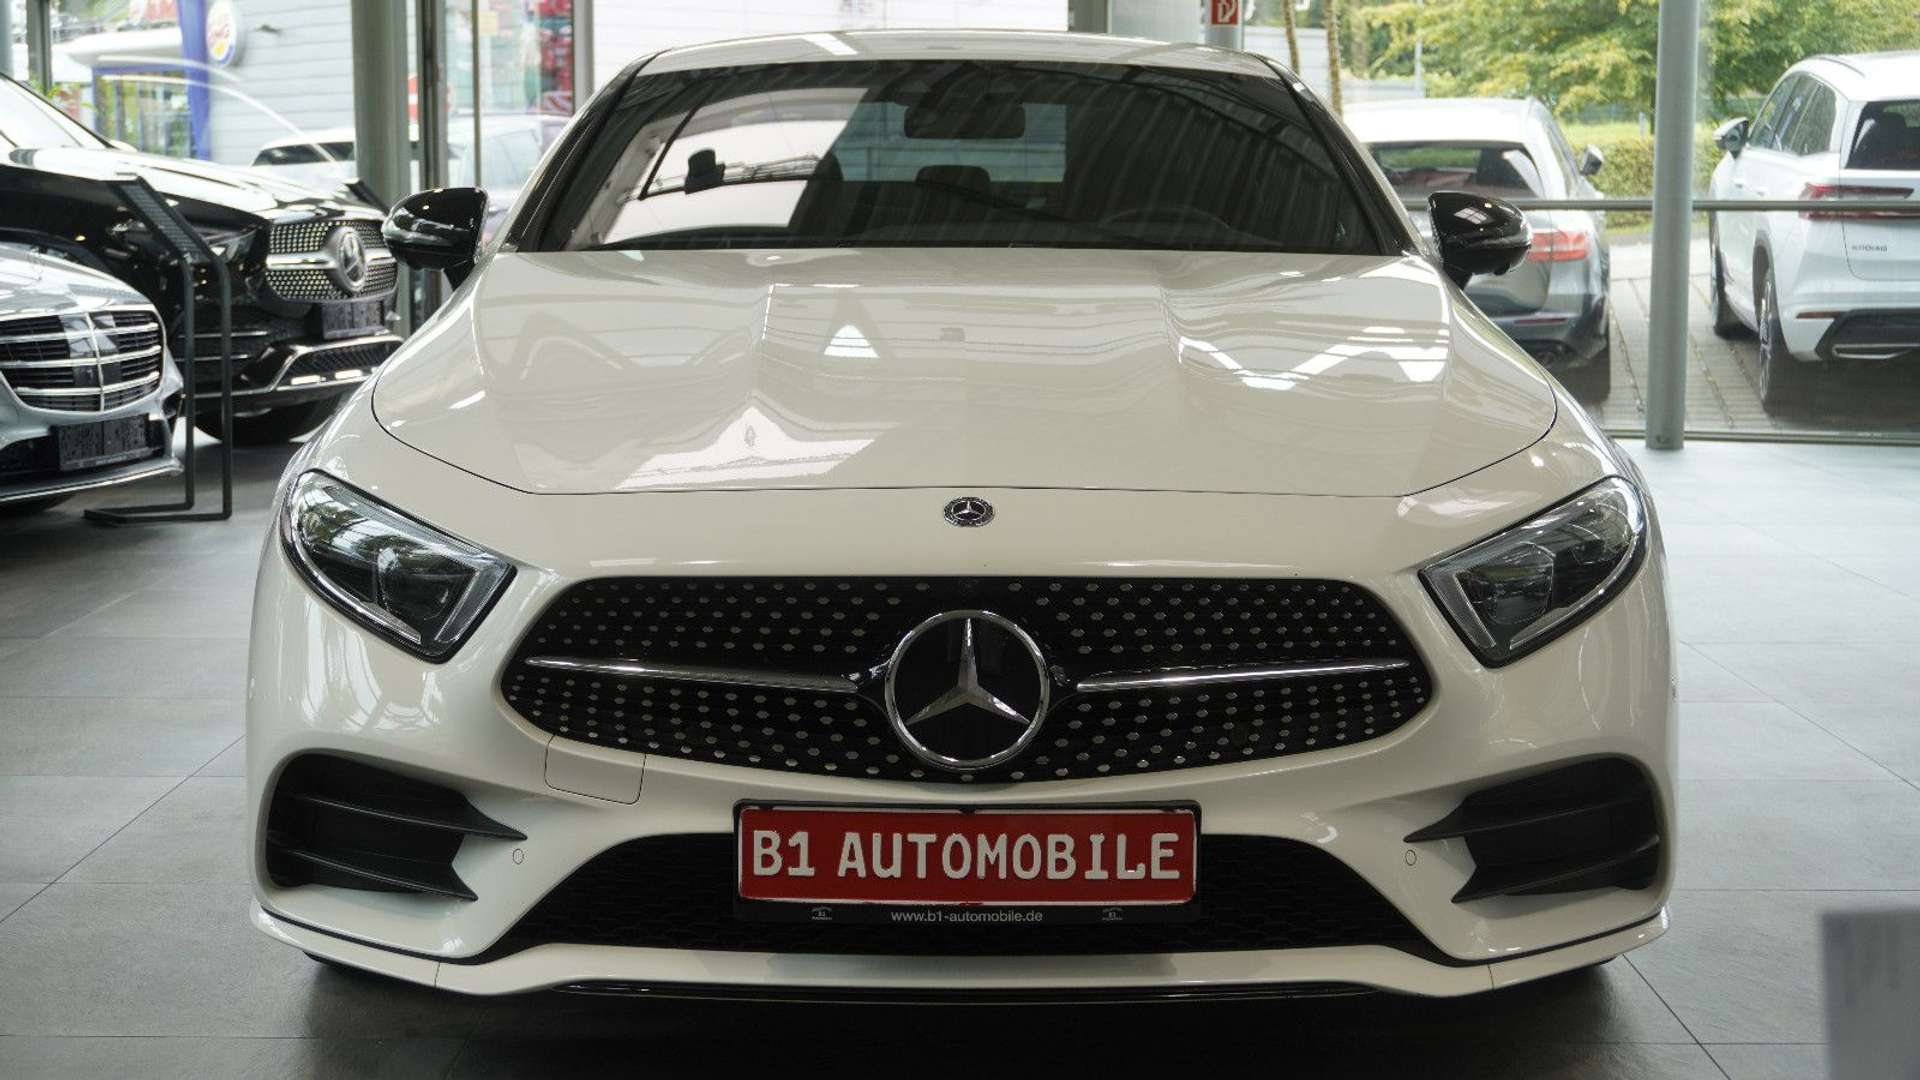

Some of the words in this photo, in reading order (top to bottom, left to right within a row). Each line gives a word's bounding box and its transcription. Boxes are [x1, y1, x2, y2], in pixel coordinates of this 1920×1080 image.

[753, 830, 815, 877] B1
[837, 832, 1180, 880] AUTOMOBILE
[891, 910, 1043, 922] www.b1-automobile.de
